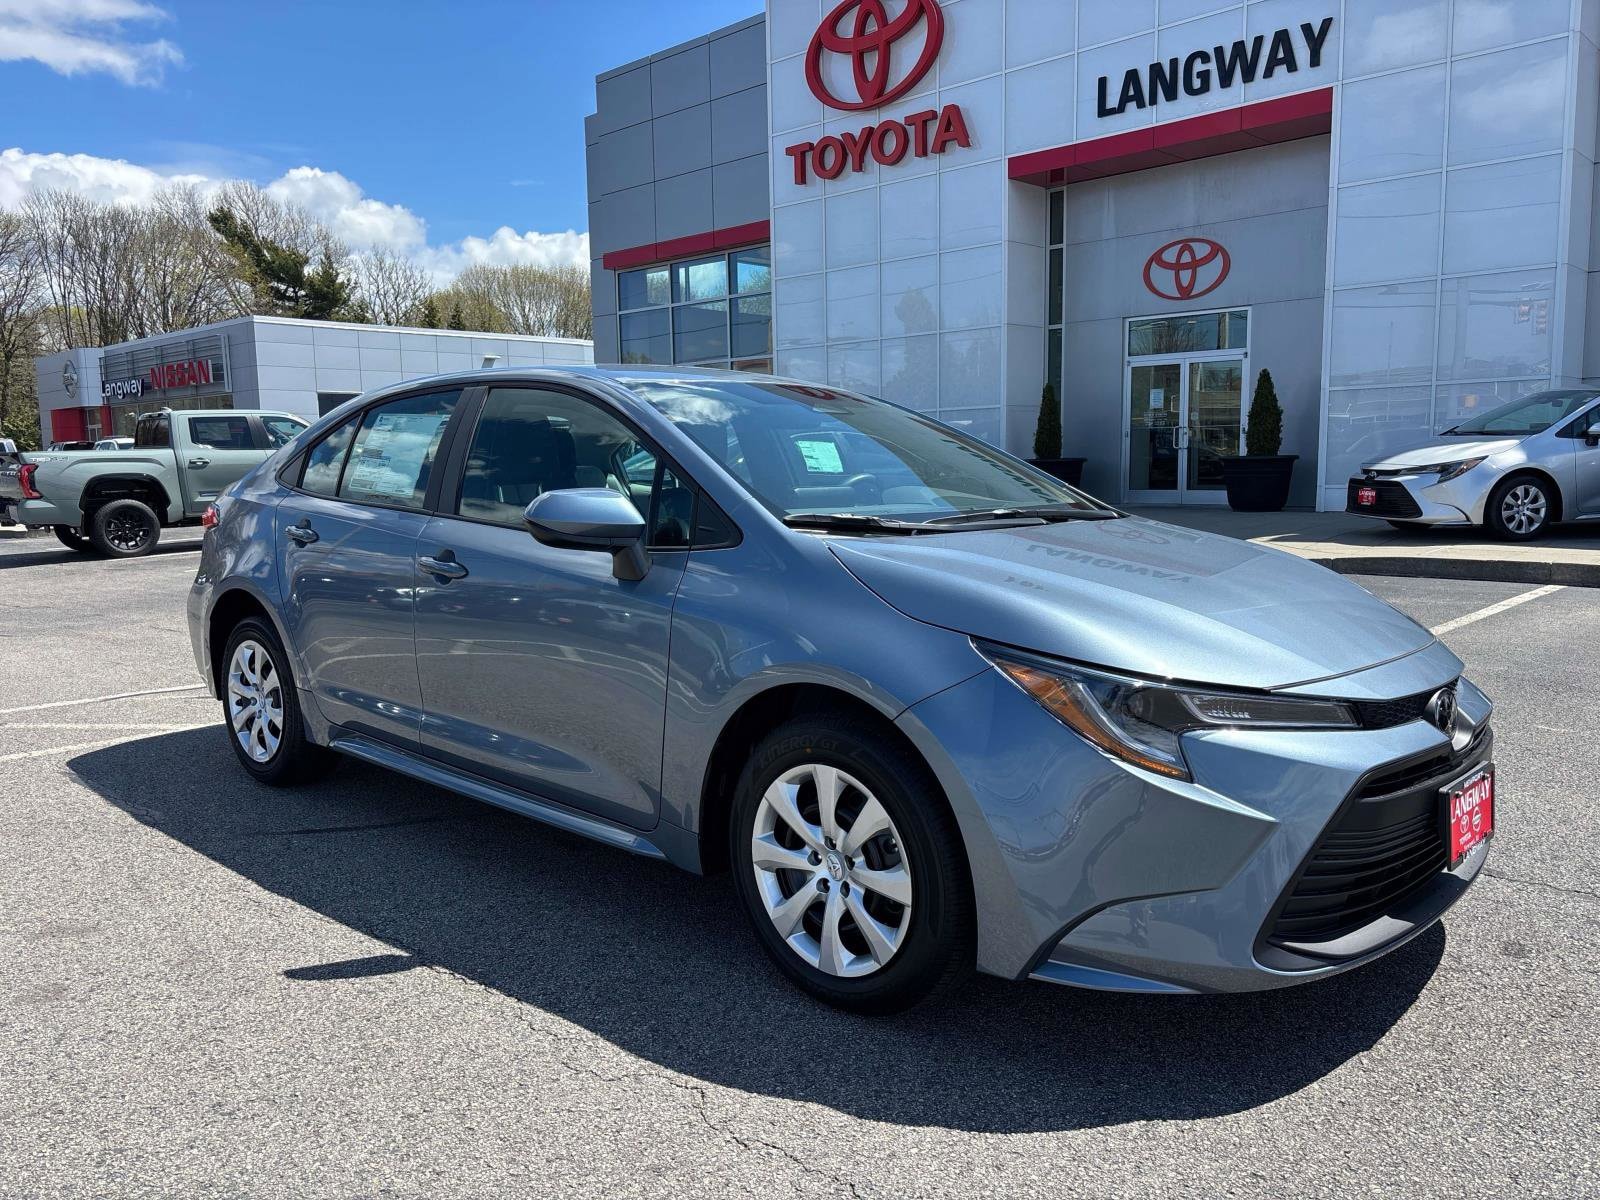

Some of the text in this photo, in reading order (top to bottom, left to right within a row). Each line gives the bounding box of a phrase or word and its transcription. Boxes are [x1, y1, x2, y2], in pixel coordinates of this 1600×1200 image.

[1097, 17, 1333, 118] LANGWAY
[786, 104, 972, 185] TOYOTA
[100, 377, 143, 398] Langway
[150, 359, 213, 389] NISSAN
[1450, 777, 1491, 824] LANGWAY
